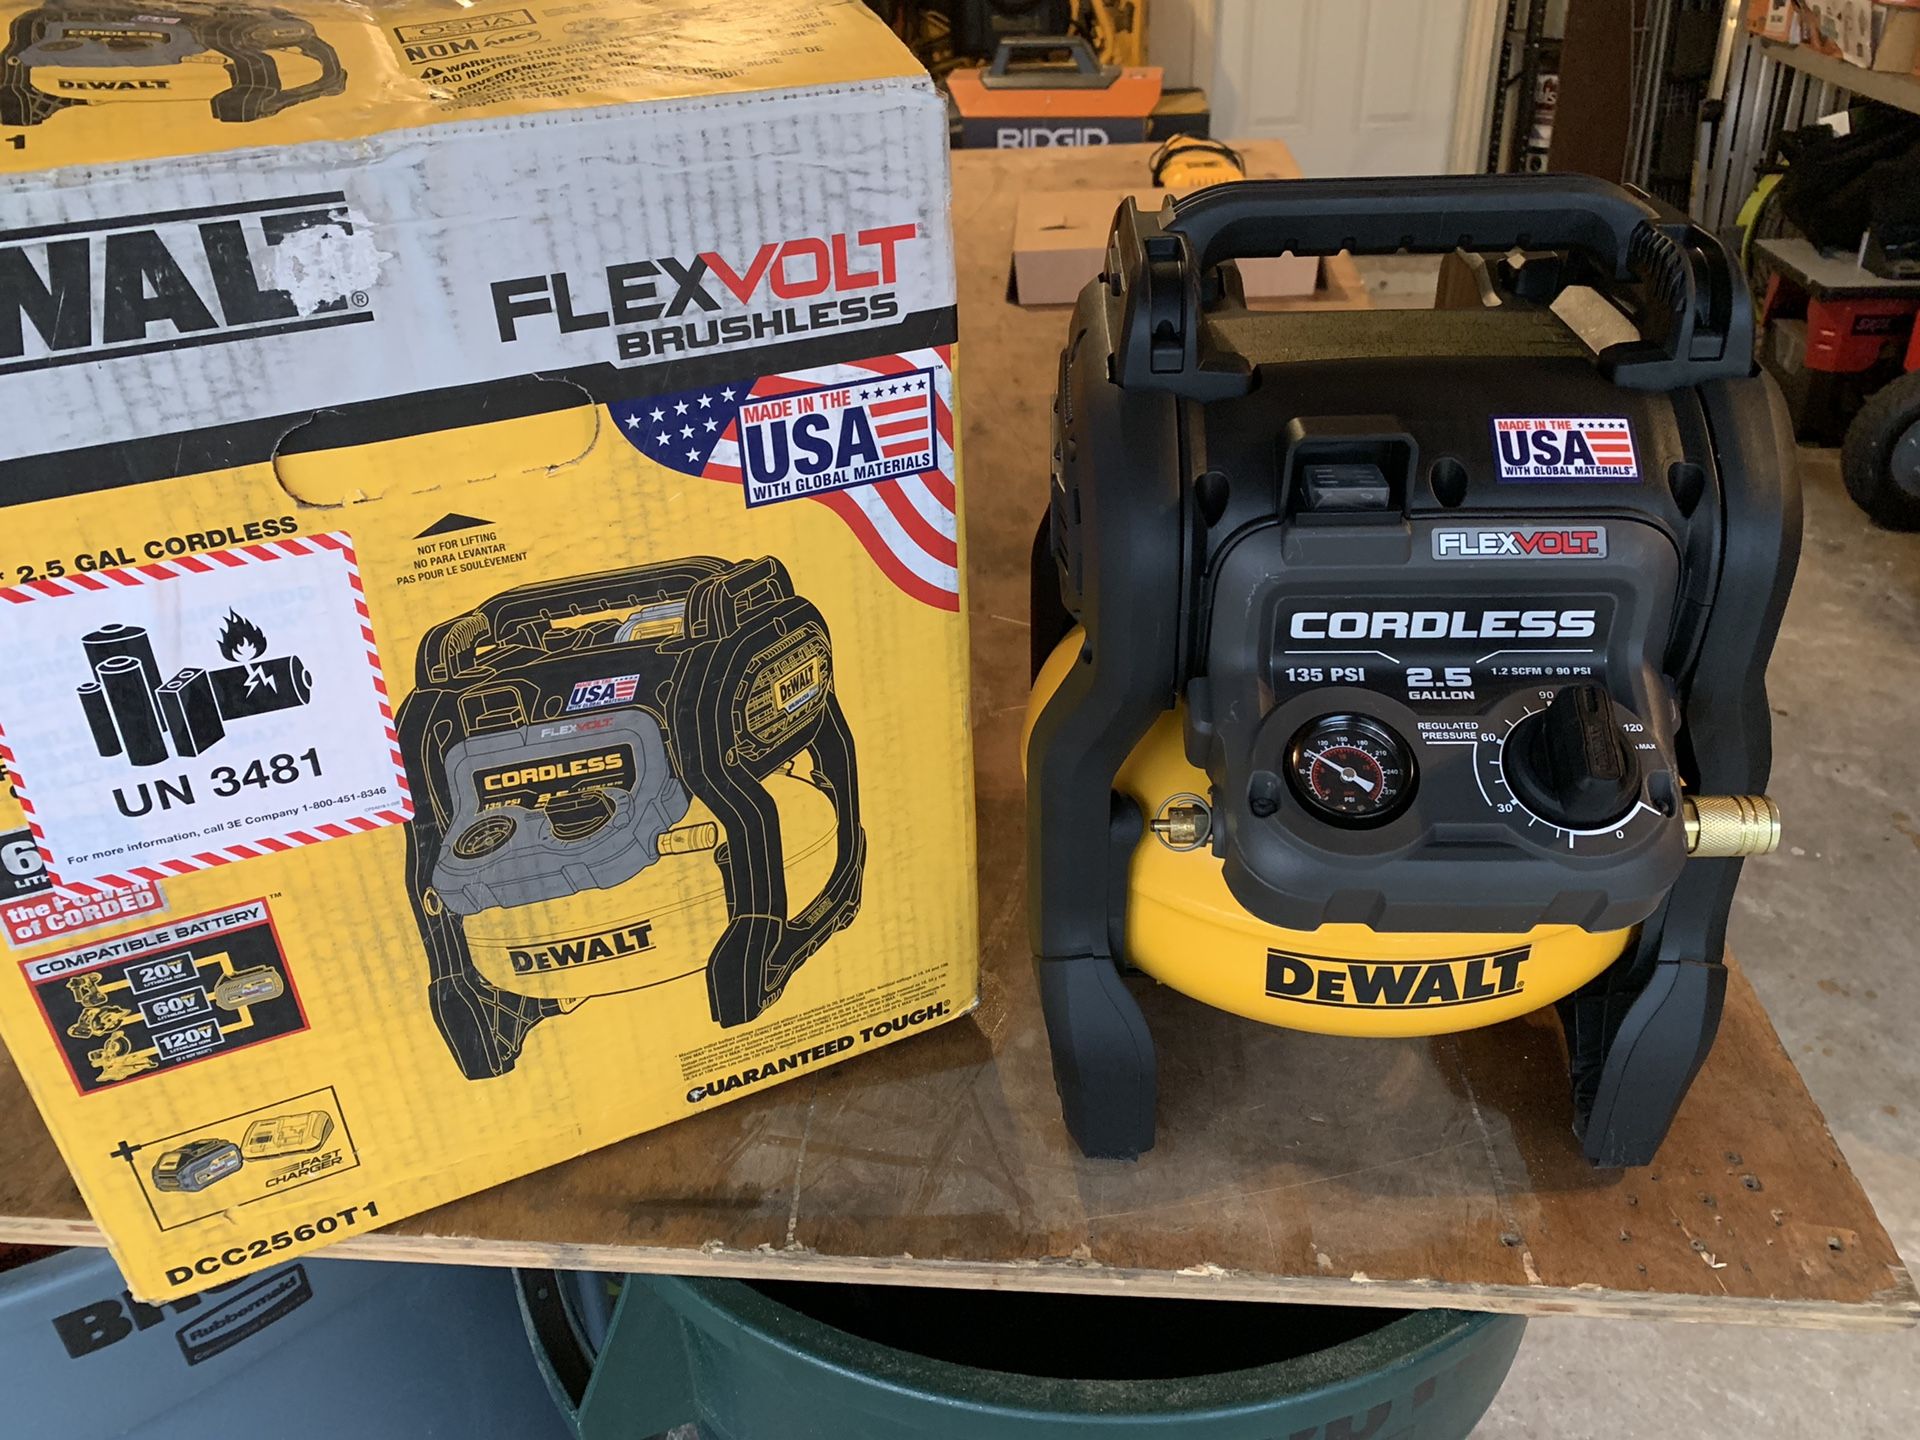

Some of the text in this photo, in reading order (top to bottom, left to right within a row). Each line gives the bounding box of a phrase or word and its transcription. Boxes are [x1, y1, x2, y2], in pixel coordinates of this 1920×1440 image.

[404, 38, 480, 62] NOM
[58, 78, 171, 91] DEWALT
[996, 127, 1110, 149] RIDGID
[490, 222, 916, 342] FLEXVOLT
[616, 292, 899, 360] BRUSHLESS
[743, 390, 852, 424] MADE IN THE
[1497, 420, 1572, 430] MADE IN THE
[745, 405, 880, 484] USA
[1499, 430, 1596, 466] USA
[753, 453, 931, 500] WITH GLOBAL MATERIALS
[1504, 466, 1631, 476] WITH GLOBAL MATERIALS
[16, 515, 299, 584] 2.5 GAL CORDLESS
[417, 531, 497, 556] NOT FOR LIFTING
[1438, 531, 1598, 556] FLEXVOLT
[396, 551, 528, 585] PAS POUR LE SOULÈVEMENT
[413, 543, 507, 570] NO PARA LEVANTAR
[1289, 610, 1597, 640] CORDLESS
[779, 664, 815, 702] DEWALT
[1285, 667, 1365, 682] 135 PSI
[1406, 667, 1474, 688] 2.5
[1491, 667, 1509, 676] 1.2
[1511, 667, 1543, 675] SCFM
[1556, 667, 1570, 675] 90
[1573, 667, 1592, 675] PSI
[570, 683, 616, 706] USA
[1408, 690, 1476, 700] GALLON
[1538, 690, 1555, 700] 90
[541, 717, 615, 738] FLEXVOLT
[1417, 722, 1479, 730] REGULATED
[1422, 731, 1478, 739] PRESSURE
[1480, 733, 1497, 742] 60
[1623, 723, 1644, 732] 120
[112, 748, 323, 818] UN 3481
[484, 753, 623, 791] CORDLESS
[1497, 803, 1513, 813] 30
[67, 854, 90, 865] For
[92, 846, 125, 860] more
[127, 830, 201, 853] information,
[203, 823, 225, 836] call
[227, 818, 243, 830] 3E
[245, 807, 299, 826] Company
[301, 786, 388, 812] 1-800-451-8346
[1615, 829, 1625, 839] 0
[7, 903, 51, 924] the
[16, 890, 155, 939] of CORDED
[35, 906, 261, 976] COMPATIBLE BATTERY
[509, 924, 653, 973] DEWALT
[139, 963, 183, 983] 20v
[1266, 949, 1532, 1005] DEWALT
[152, 996, 196, 1016] 60v
[160, 1027, 213, 1050] 120v
[686, 1035, 855, 1104] GUARANTEED
[859, 1002, 951, 1043] TOUGH.
[300, 1148, 342, 1170] FAST
[265, 1156, 344, 1188] CHARGER
[165, 1201, 380, 1287] DCC2560T1
[188, 1275, 298, 1342] Rubbermaid
